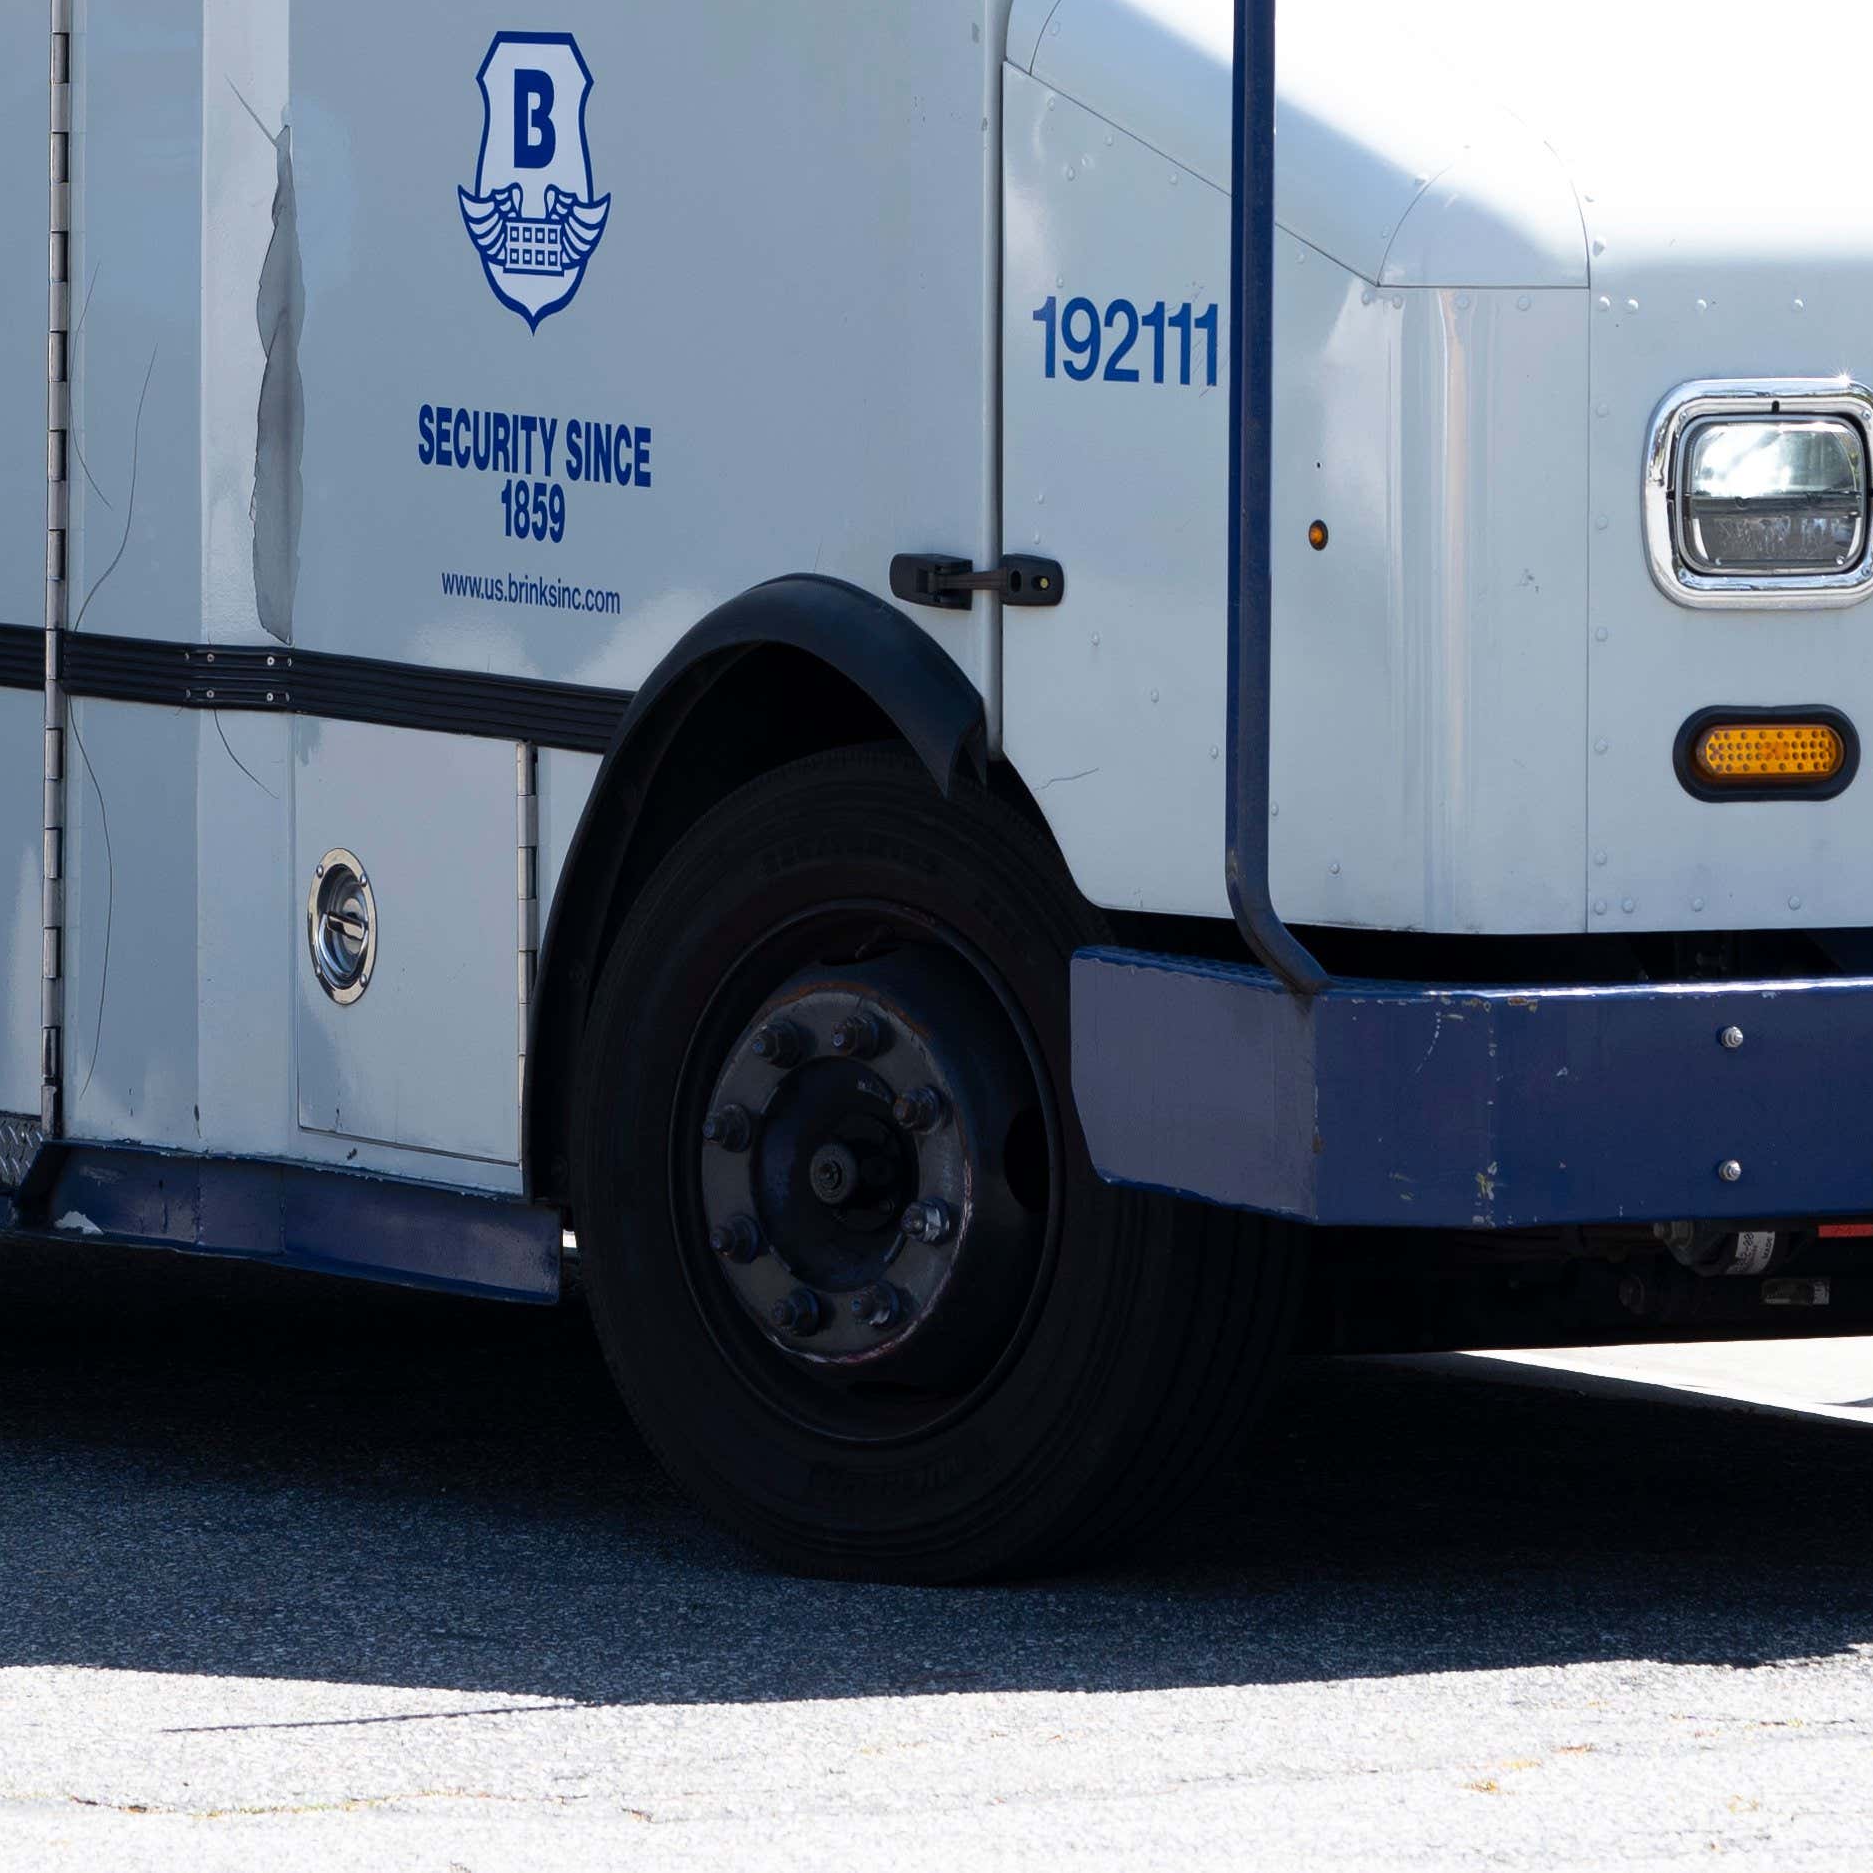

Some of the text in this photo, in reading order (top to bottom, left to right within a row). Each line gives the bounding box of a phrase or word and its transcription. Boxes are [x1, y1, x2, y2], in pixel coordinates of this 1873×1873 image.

[513, 68, 557, 170] B
[1032, 295, 1219, 387] 192111
[418, 404, 653, 489] SECURITY SINCE
[500, 480, 566, 544] 1859
[441, 572, 622, 615] www.us.brinksinc.com
